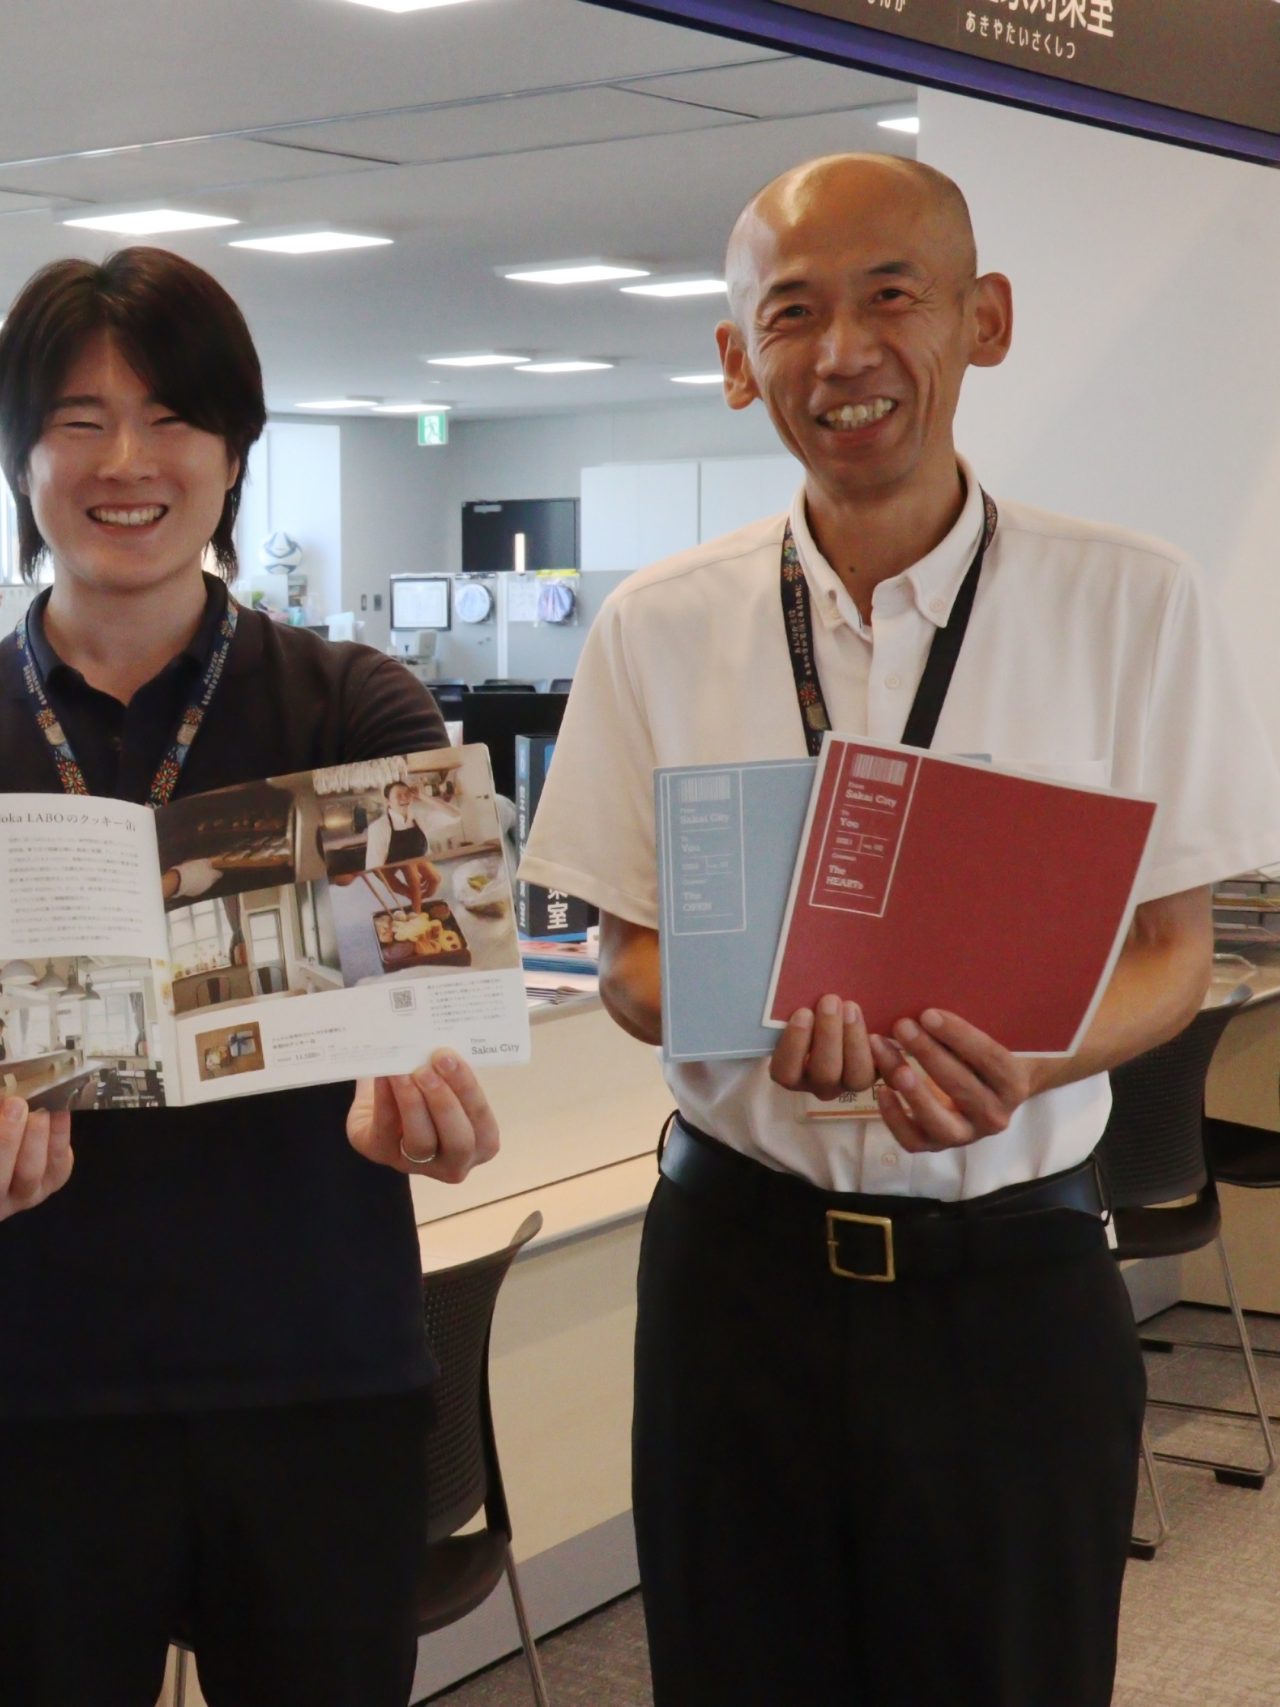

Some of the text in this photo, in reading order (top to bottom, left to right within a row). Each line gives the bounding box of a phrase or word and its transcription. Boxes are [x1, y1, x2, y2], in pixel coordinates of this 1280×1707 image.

[965, 11, 1076, 59] あきやたいさくしつ
[845, 790, 897, 808] Sakai City
[840, 817, 859, 829] You
[829, 864, 847, 876] The
[471, 1043, 520, 1056] Sakai City
